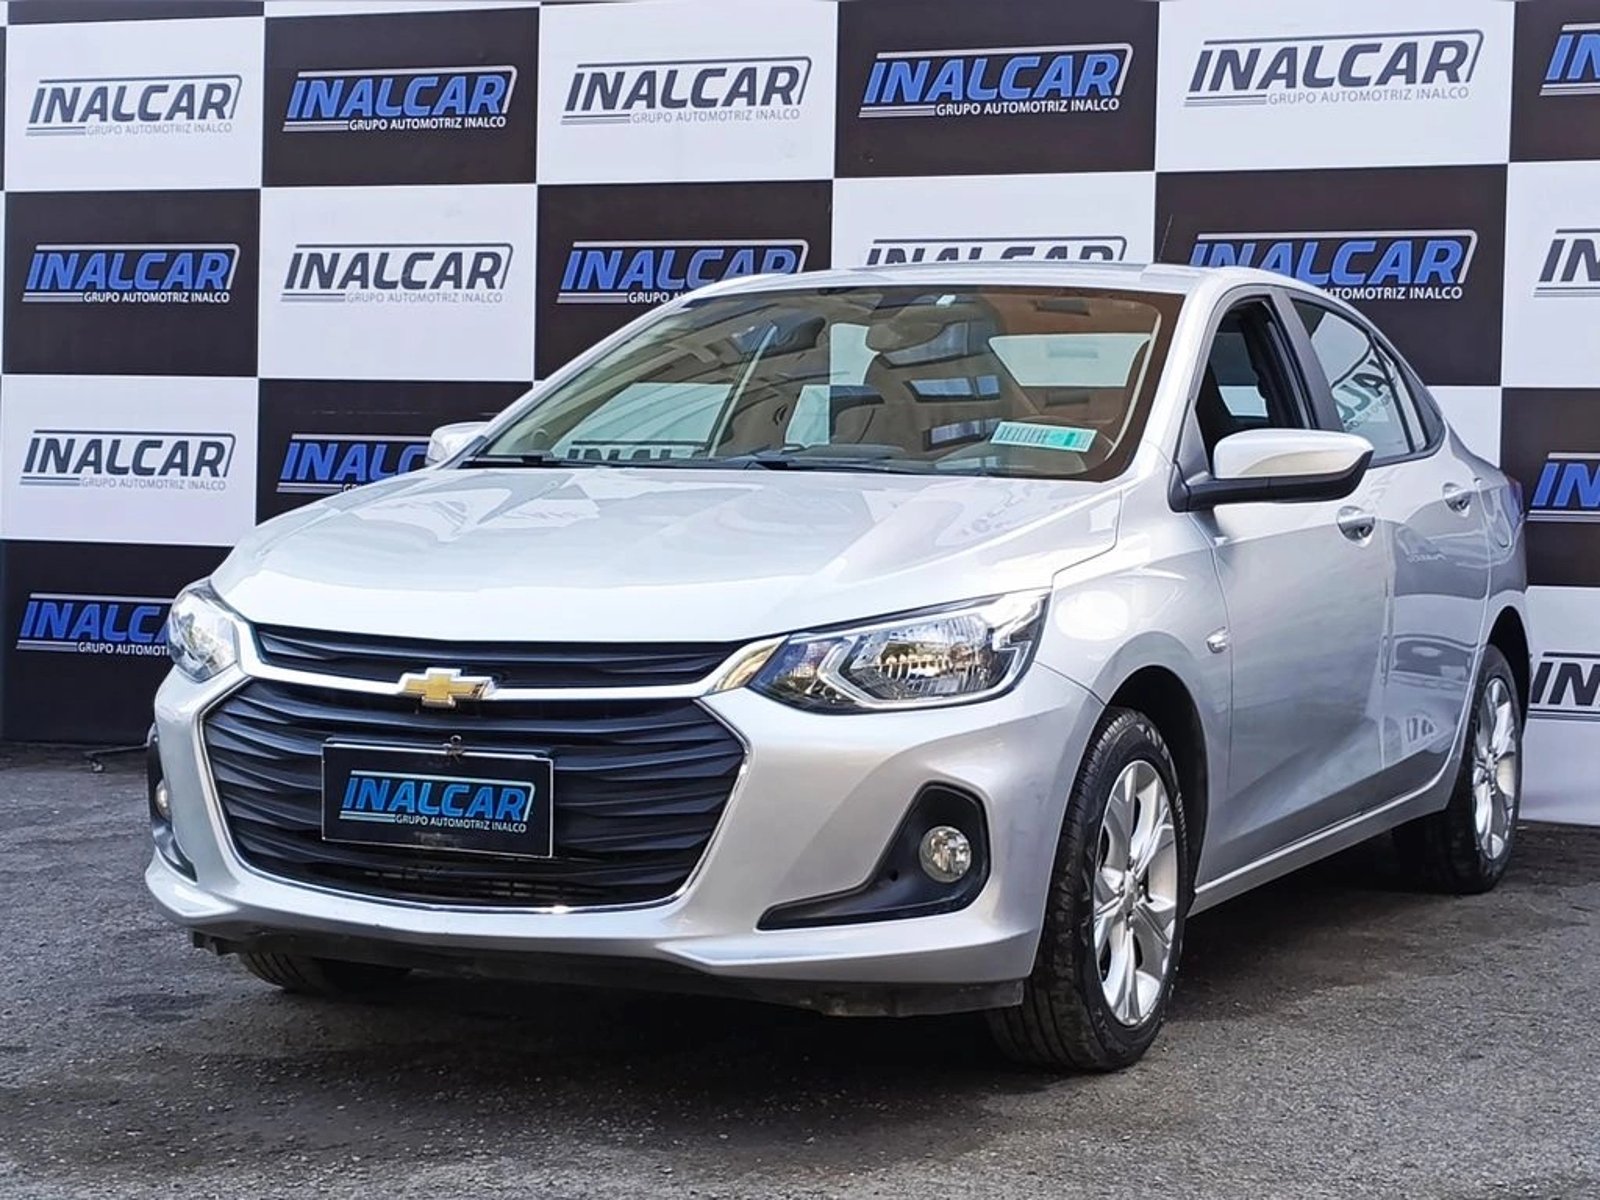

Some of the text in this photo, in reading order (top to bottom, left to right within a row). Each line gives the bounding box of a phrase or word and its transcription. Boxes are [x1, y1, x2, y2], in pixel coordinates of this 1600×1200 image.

[1188, 40, 1469, 92] INALCAR
[564, 66, 800, 111] INALCAR
[863, 53, 1120, 104] INALCAR
[29, 83, 232, 124] INALCAR
[286, 74, 506, 119] INALCAR
[1268, 86, 1469, 106] GRUPO AUTOMOTRIZ INALCO
[632, 108, 800, 124] GRUPO AUTOMOTRIZ INALCO
[936, 98, 1120, 117] GRUPO AUTOMOTRIZ INALCO
[87, 122, 232, 136] GRUPO AUTOMOTRIZ INALCO
[350, 116, 506, 131] GRUPO AUTOMOTRIZ INALCO
[25, 252, 229, 290] INALCAR
[284, 251, 502, 290] INALCAR
[84, 291, 230, 303] GRUPO AUTOMOTRIZ INALCO
[347, 291, 502, 303] GRUPO AUTOMOTRIZ INALCO
[628, 291, 669, 304] GRUPO
[1409, 286, 1463, 300] INALCO
[23, 438, 226, 477] INALCAR
[280, 442, 429, 481] INALC
[82, 478, 226, 491] GRUPO AUTOMOTRIZ INALCO
[20, 601, 170, 643] INALC
[78, 642, 169, 656] GRUPO AUTOMOT
[342, 777, 526, 821] INALCAR
[396, 814, 527, 833] GRUPO AUTOMOTRIZ INALCO
